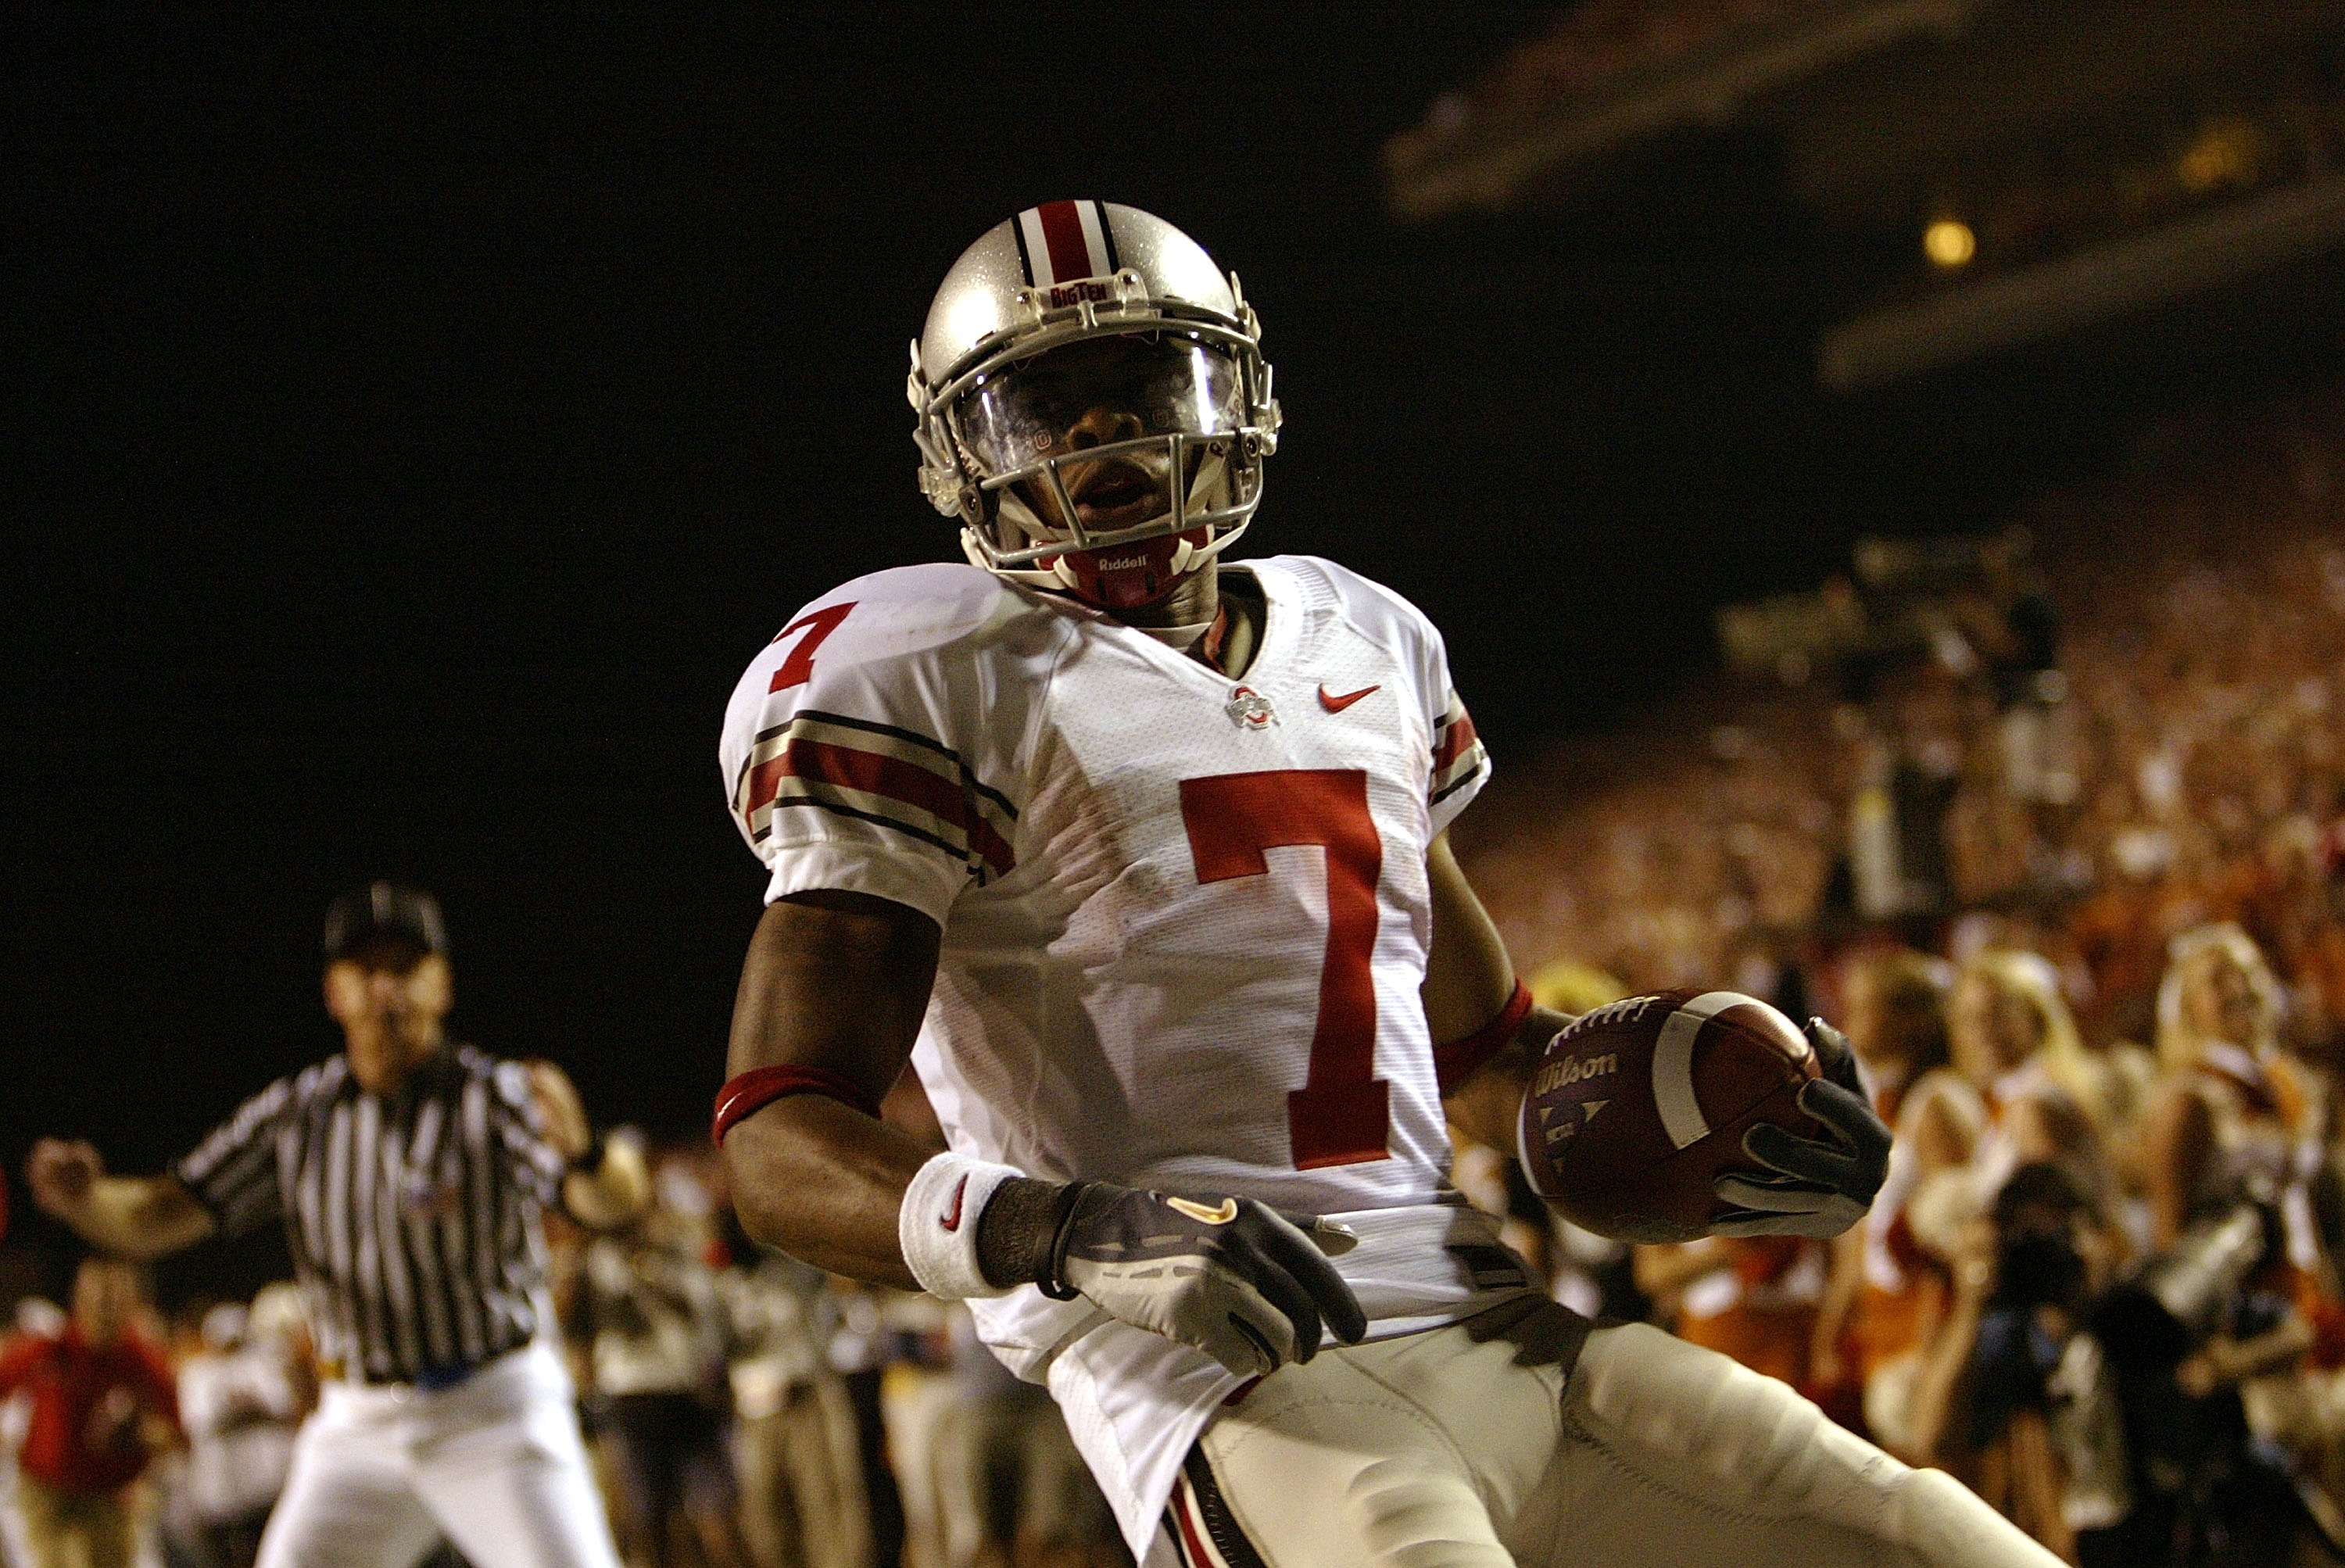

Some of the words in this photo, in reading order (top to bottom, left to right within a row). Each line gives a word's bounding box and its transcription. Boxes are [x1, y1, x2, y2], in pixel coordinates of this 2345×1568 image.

[1099, 554, 1147, 571] Riddell
[768, 600, 860, 695] 7
[1179, 769, 1391, 1170] 7
[1534, 1053, 1618, 1097] Wilson
